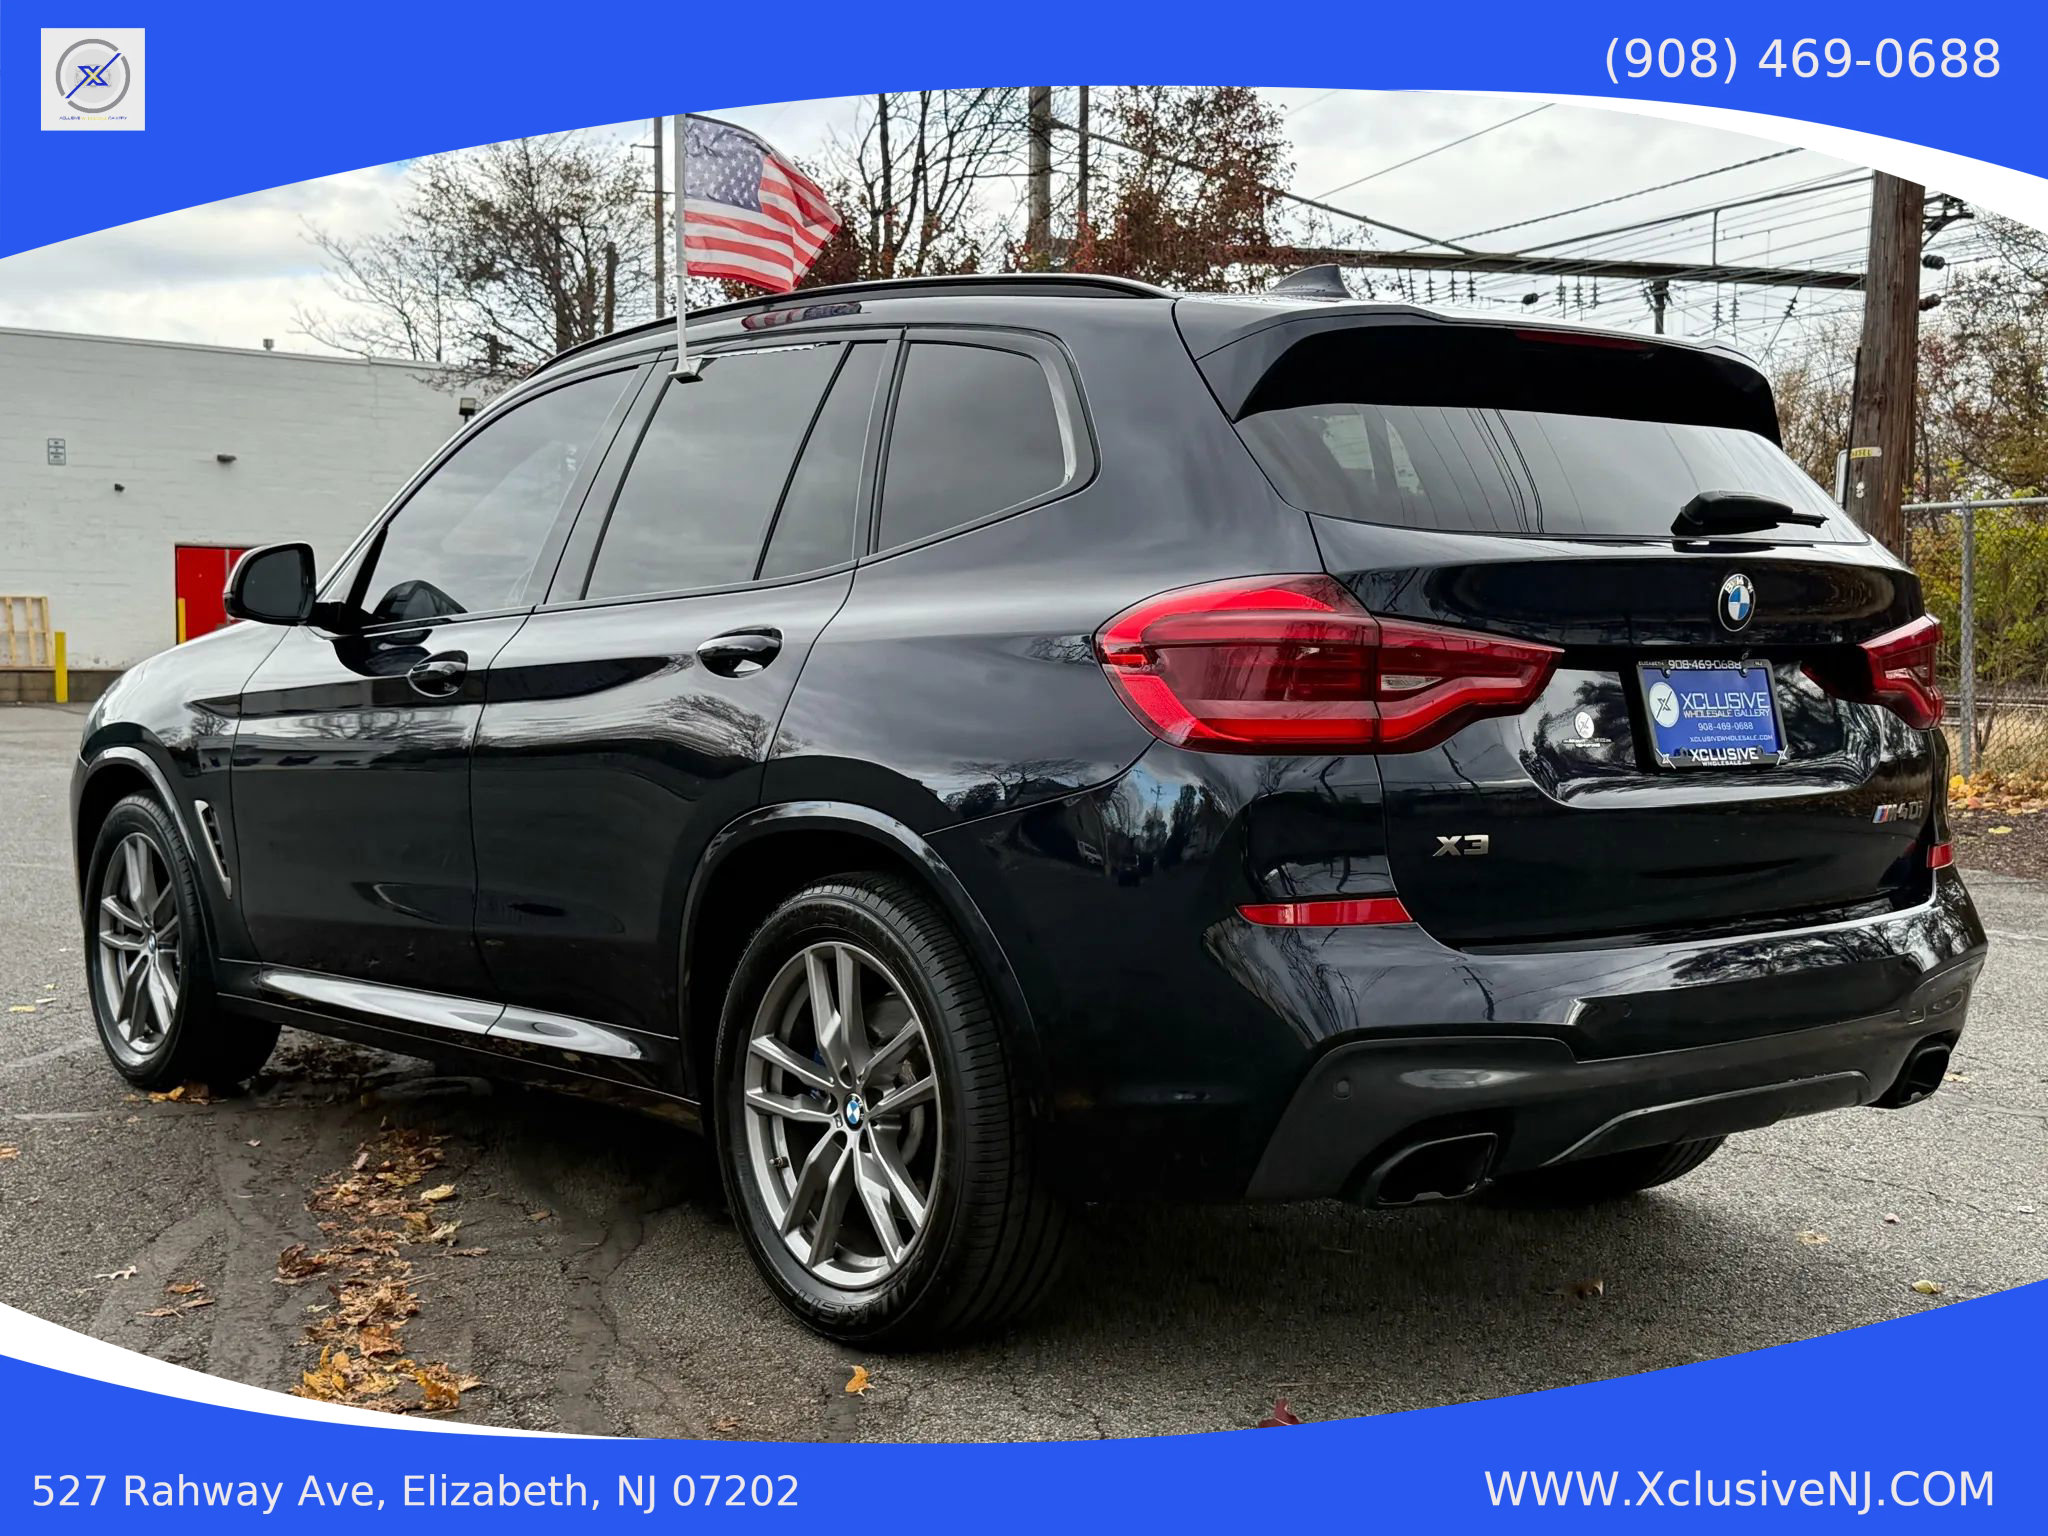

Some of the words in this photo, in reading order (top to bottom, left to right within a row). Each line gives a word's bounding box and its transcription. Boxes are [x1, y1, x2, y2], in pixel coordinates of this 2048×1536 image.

[1725, 576, 1755, 594] BMW
[1668, 660, 1742, 670] 908-469-0688
[1680, 692, 1770, 709] XCLUSIVE
[1683, 709, 1733, 719] WHOLESALE
[1734, 708, 1770, 718] GALLERY
[1697, 722, 1754, 731] 908-469-0688
[1689, 734, 1773, 743] XCLUSIVEWHOLESALE.COM
[1689, 747, 1760, 762] XCLUSIVE
[1432, 834, 1489, 857] X3
